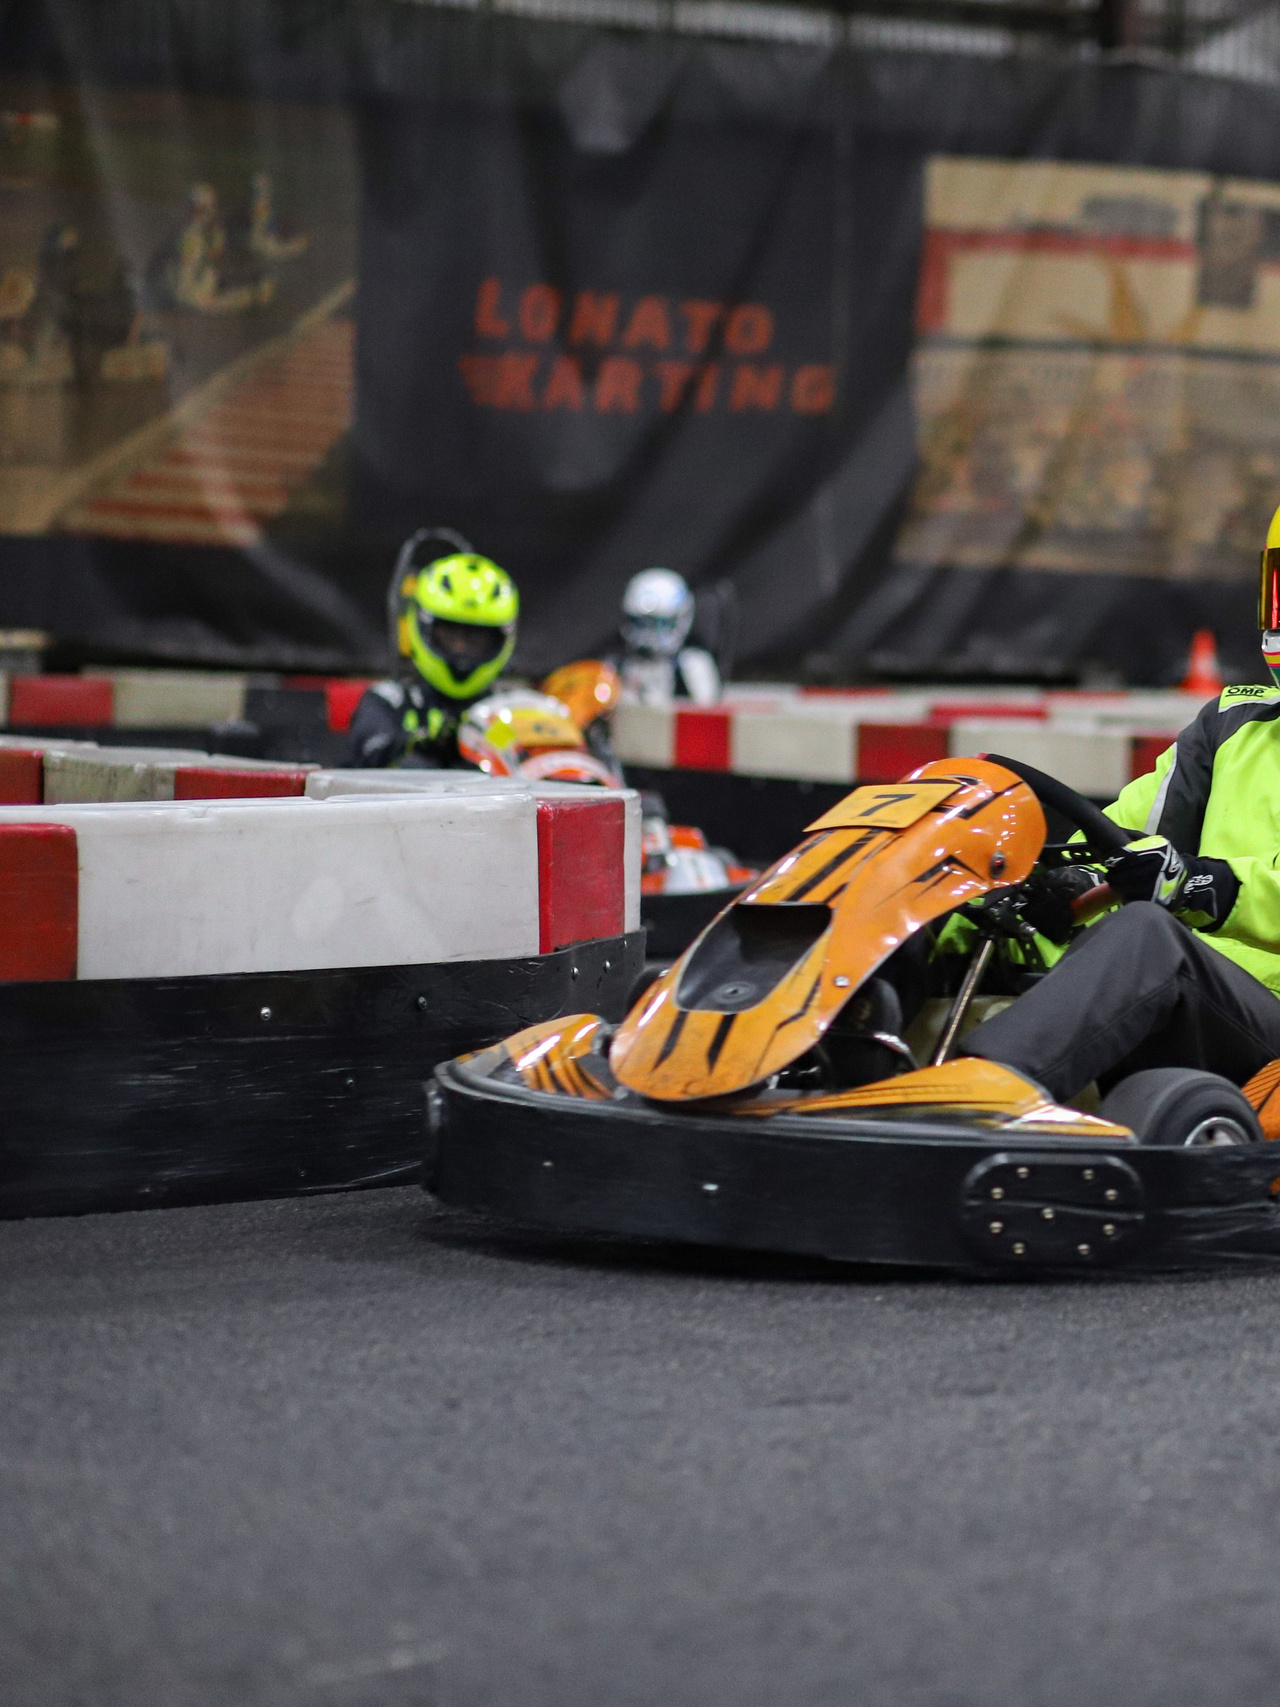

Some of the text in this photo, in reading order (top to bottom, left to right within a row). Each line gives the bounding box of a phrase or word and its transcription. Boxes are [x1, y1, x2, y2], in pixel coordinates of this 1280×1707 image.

[474, 277, 774, 354] LONATO
[459, 350, 840, 414] KARTING
[1227, 686, 1266, 696] OMP
[858, 793, 917, 817] 7
